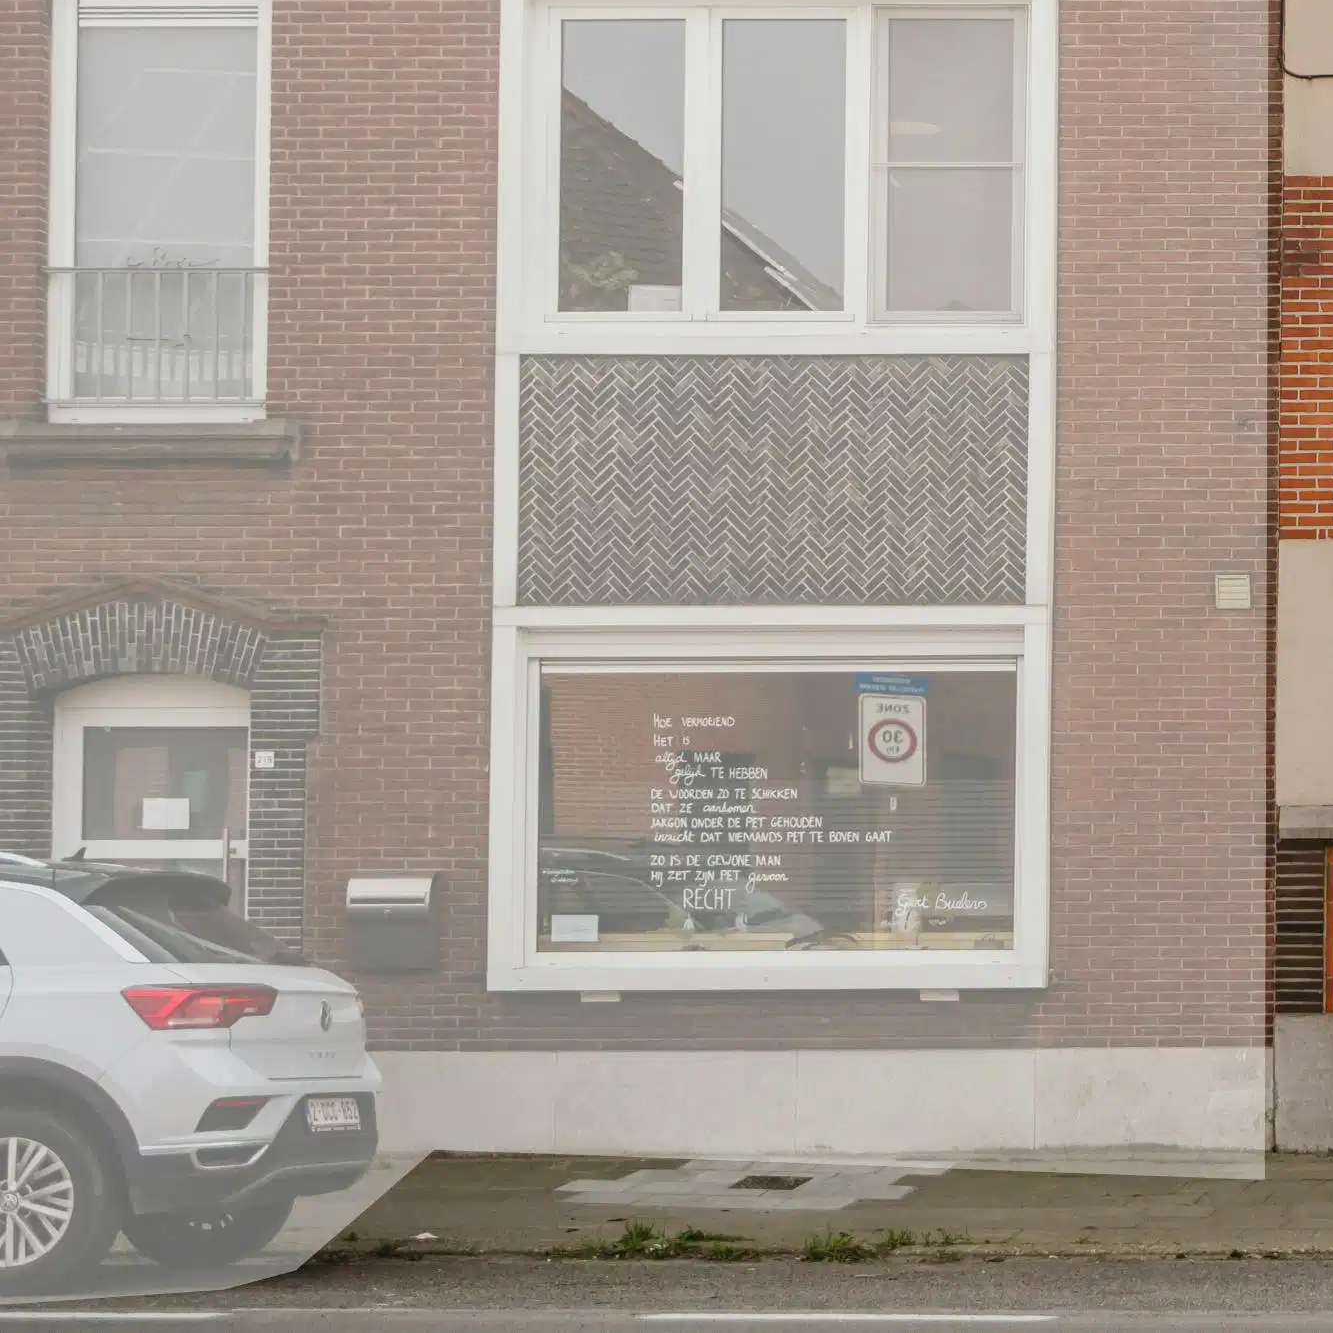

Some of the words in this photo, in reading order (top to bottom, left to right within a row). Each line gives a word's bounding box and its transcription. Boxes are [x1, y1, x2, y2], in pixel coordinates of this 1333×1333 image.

[693, 752, 722, 763] MAAR
[710, 767, 724, 779] TE
[729, 767, 768, 779] HEBBEN
[651, 788, 663, 800] DE
[669, 788, 713, 799] WOORDEN
[716, 788, 729, 799] ZO
[734, 788, 746, 799] TE
[752, 788, 798, 799] SCHIKKEN
[651, 803, 673, 813] DAT
[679, 803, 693, 814] ZE
[650, 817, 687, 829] JARGON
[691, 817, 724, 828] ONDER
[727, 817, 741, 828] DE
[745, 816, 766, 828] PET
[770, 816, 823, 828] GEHOUDEN
[700, 831, 723, 843] DAT
[728, 831, 783, 843] NIEMANDS
[786, 831, 805, 843] PET
[809, 831, 823, 843] TE
[829, 831, 860, 843] BOVEN
[865, 831, 892, 843] GAAT
[650, 854, 666, 866] ZO
[670, 855, 682, 866] IS
[686, 855, 701, 866] DE
[707, 855, 750, 866] GEWONE
[755, 855, 781, 866] MAN
[667, 870, 691, 880] ZET
[720, 869, 741, 881] PET
[683, 888, 736, 910] RECHT
